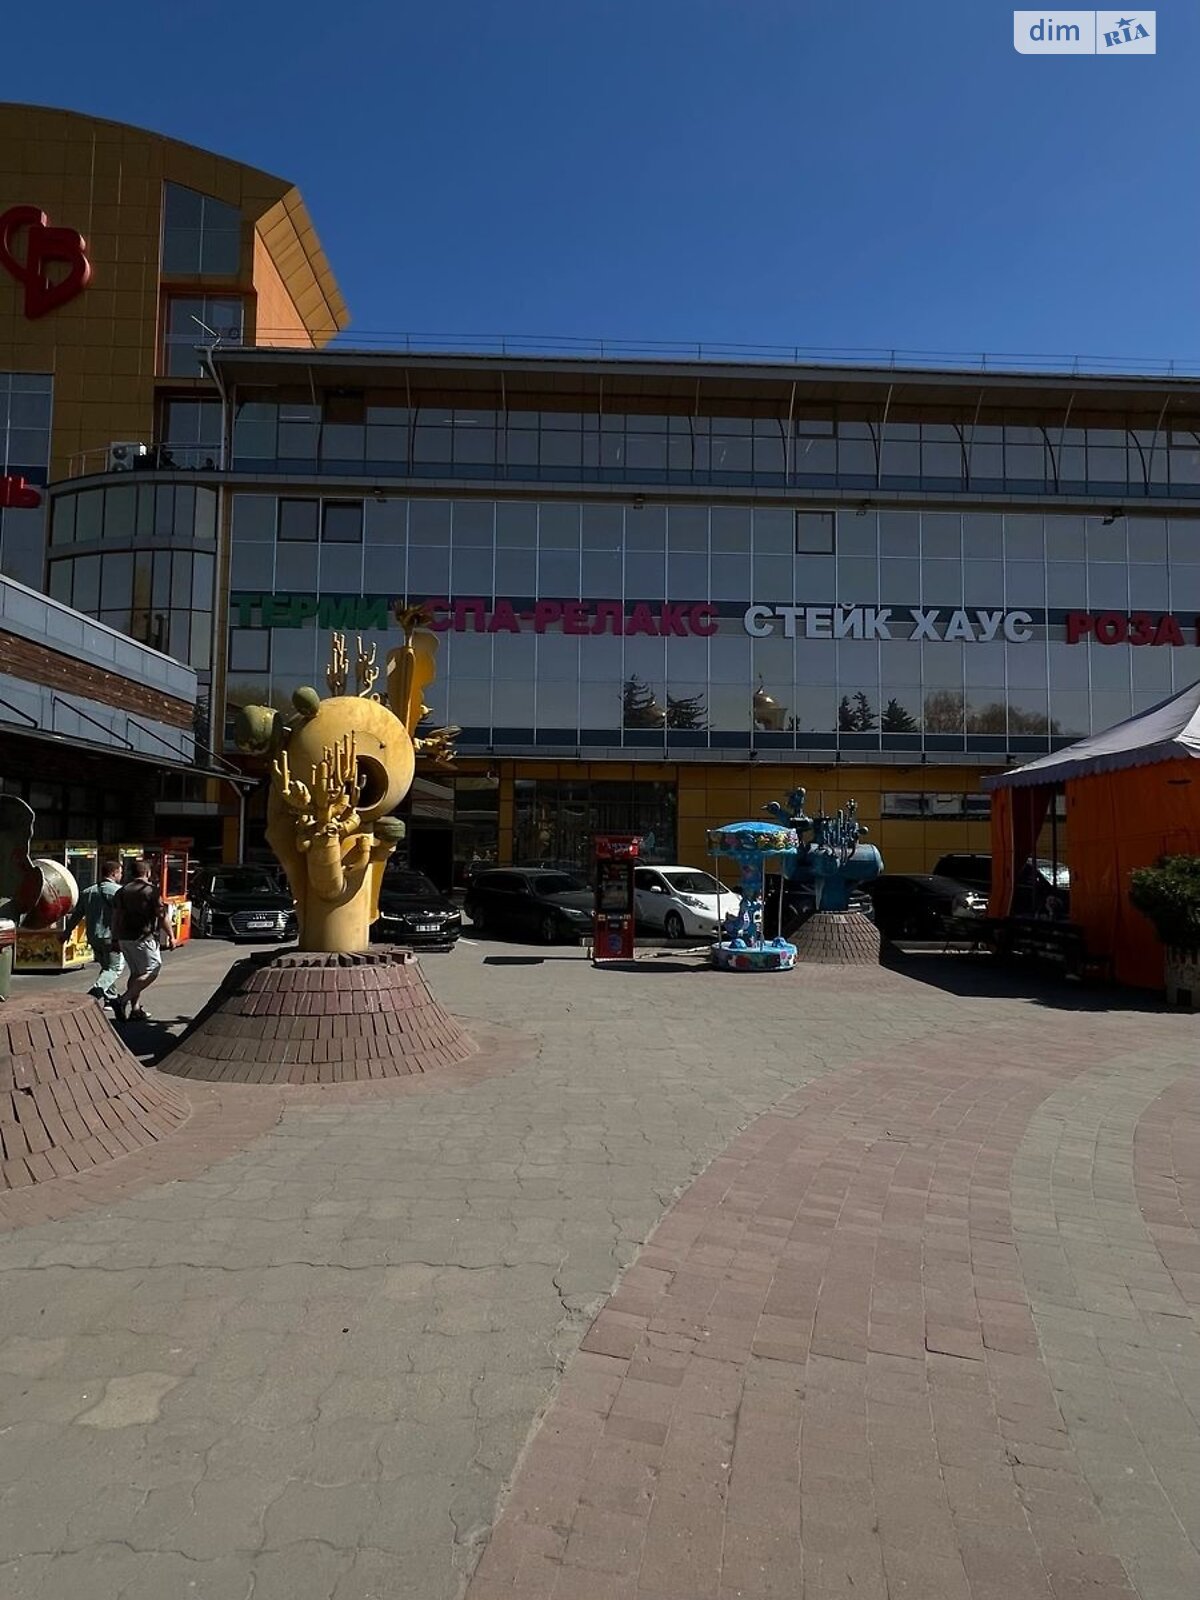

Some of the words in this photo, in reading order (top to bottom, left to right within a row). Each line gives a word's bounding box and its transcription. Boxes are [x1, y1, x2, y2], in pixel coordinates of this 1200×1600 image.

[231, 595, 388, 630] ТЕРМИ
[425, 597, 719, 637] СПА-РЕЛАКС
[744, 603, 892, 640] СТЕЙК
[909, 609, 1034, 642] ХАУС
[1066, 611, 1184, 646] РОЗА
